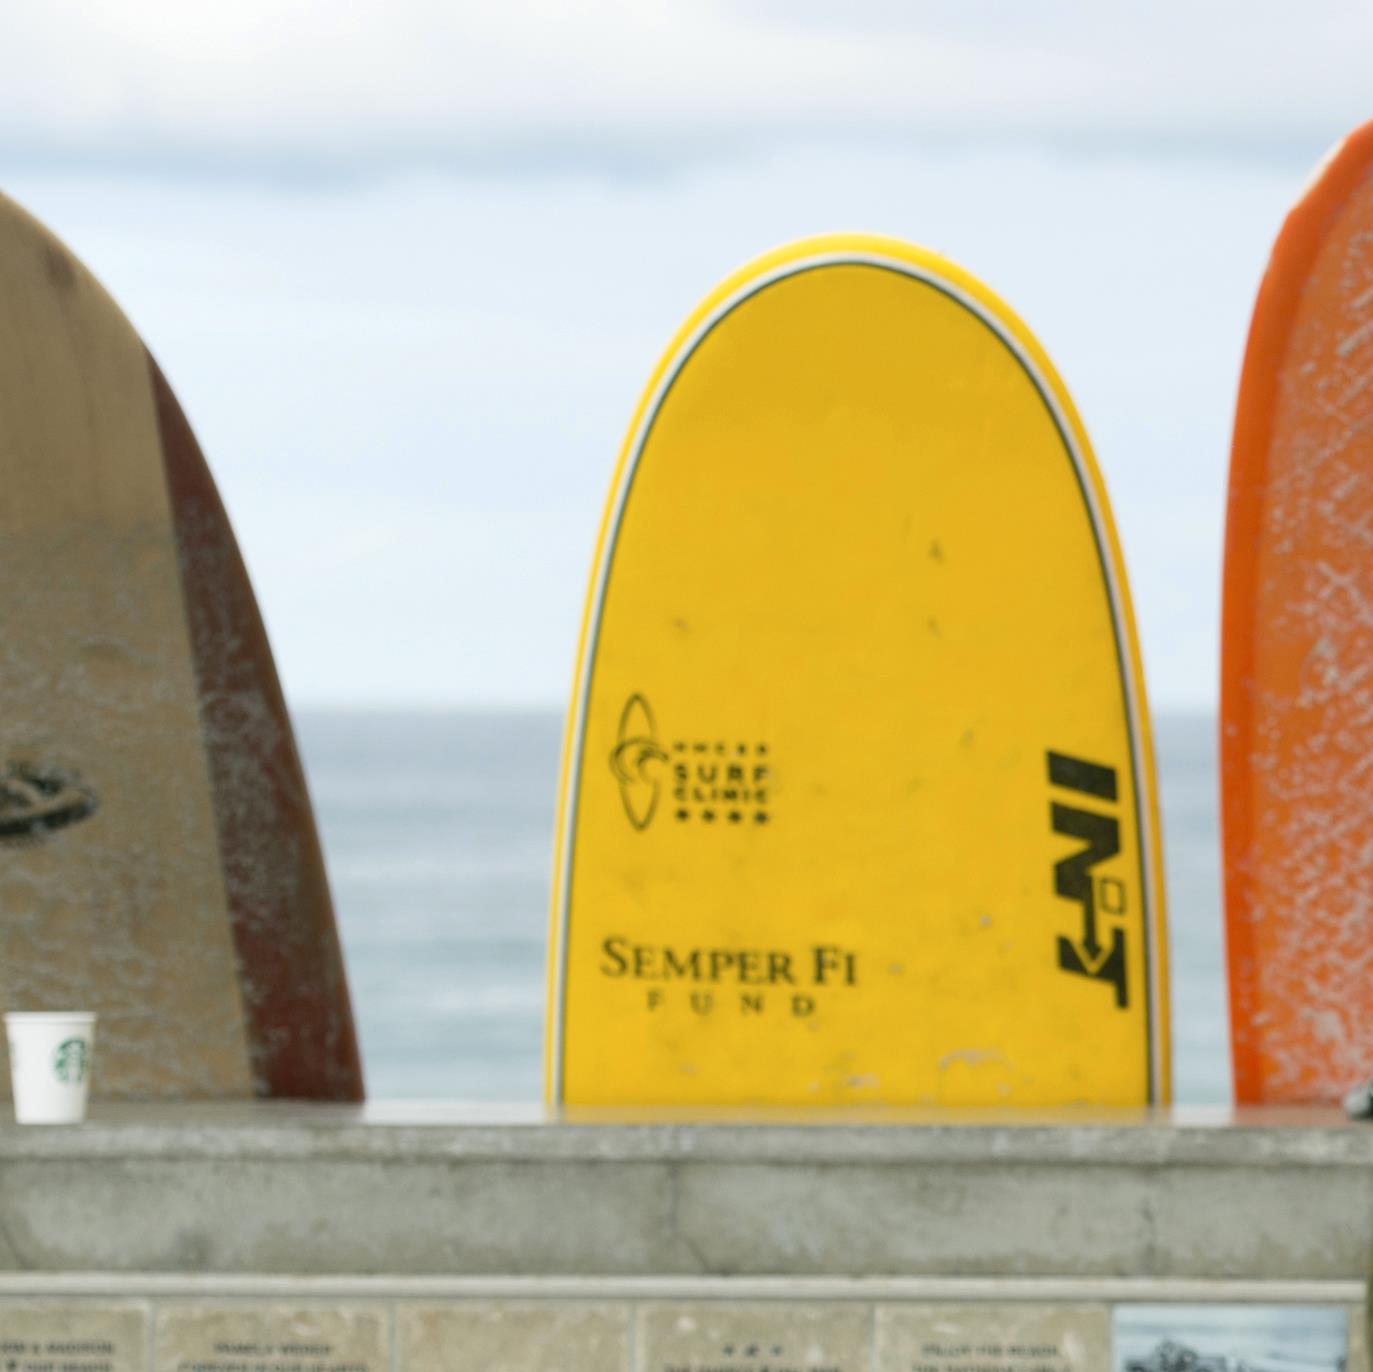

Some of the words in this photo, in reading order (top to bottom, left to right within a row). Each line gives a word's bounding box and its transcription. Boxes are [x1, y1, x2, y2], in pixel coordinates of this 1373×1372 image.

[674, 763, 772, 785] SURF
[673, 785, 769, 804] CLINIC
[647, 990, 817, 1020] FUND
